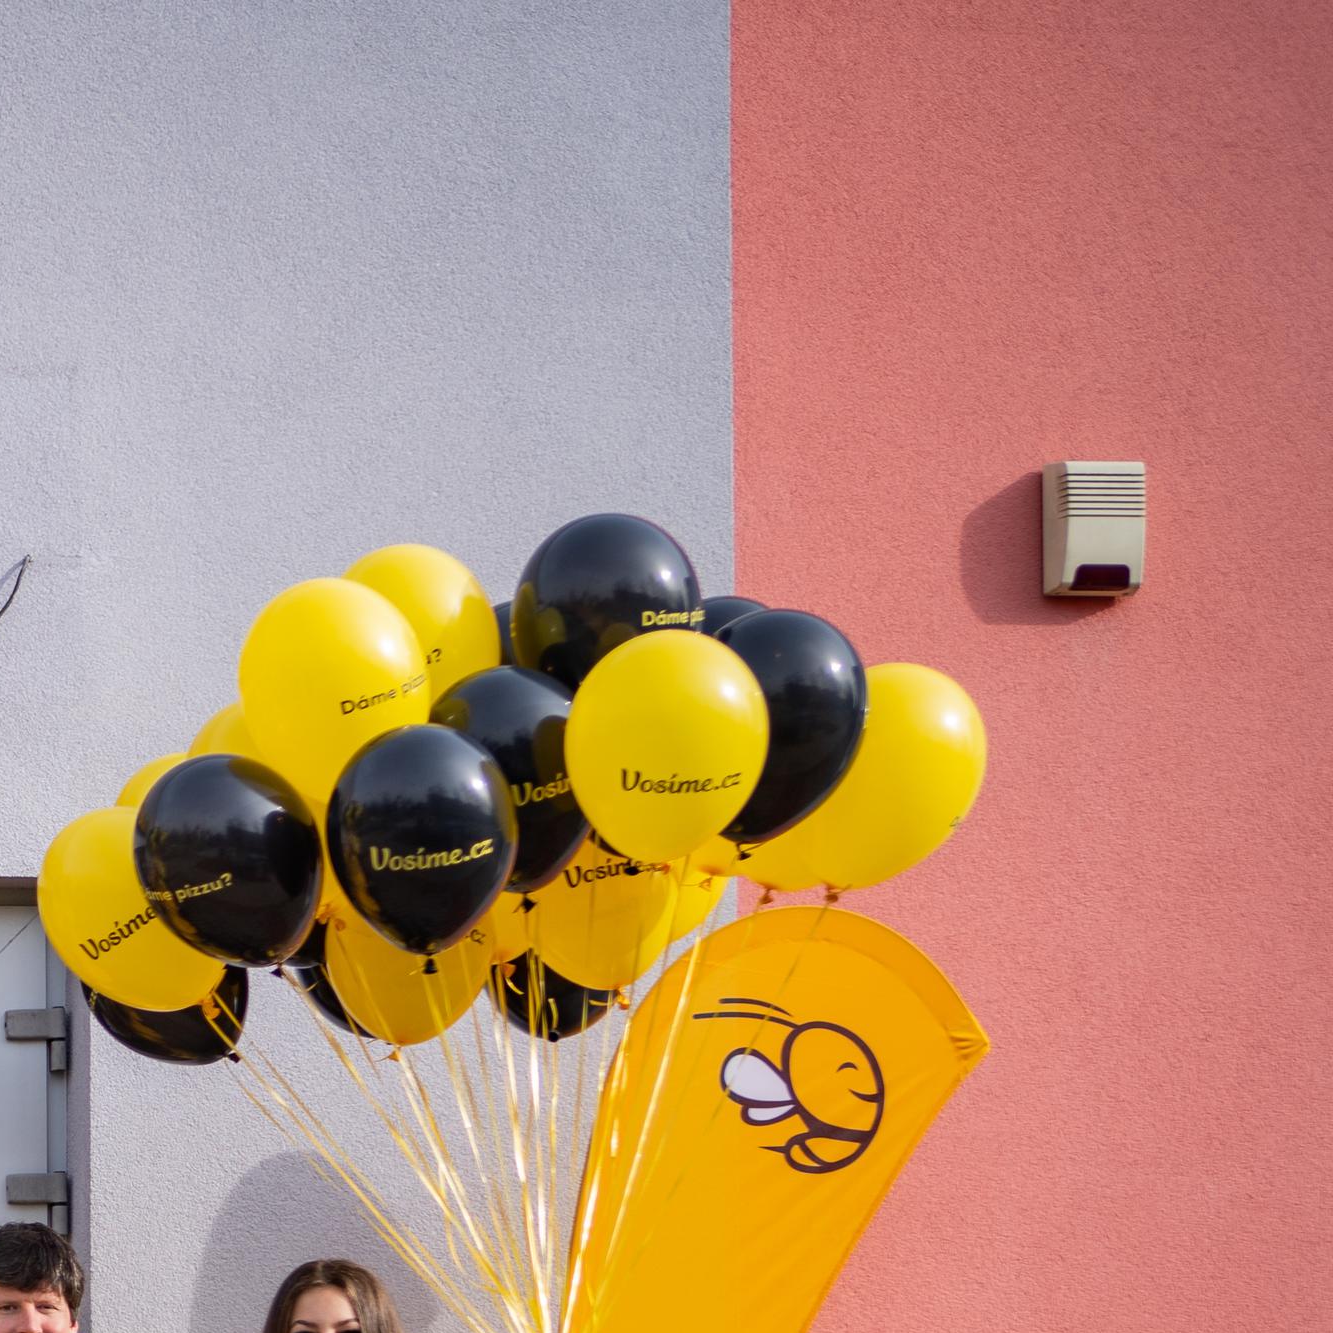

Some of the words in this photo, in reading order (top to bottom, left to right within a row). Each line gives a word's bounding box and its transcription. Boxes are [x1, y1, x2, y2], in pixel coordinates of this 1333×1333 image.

[642, 609, 689, 627] Dáme
[340, 688, 398, 716] Dáme
[621, 768, 741, 795] Vosíme.cz
[370, 837, 494, 872] Vosíme.cz
[175, 871, 233, 904] pizzu?
[78, 904, 156, 961] Vosíme
